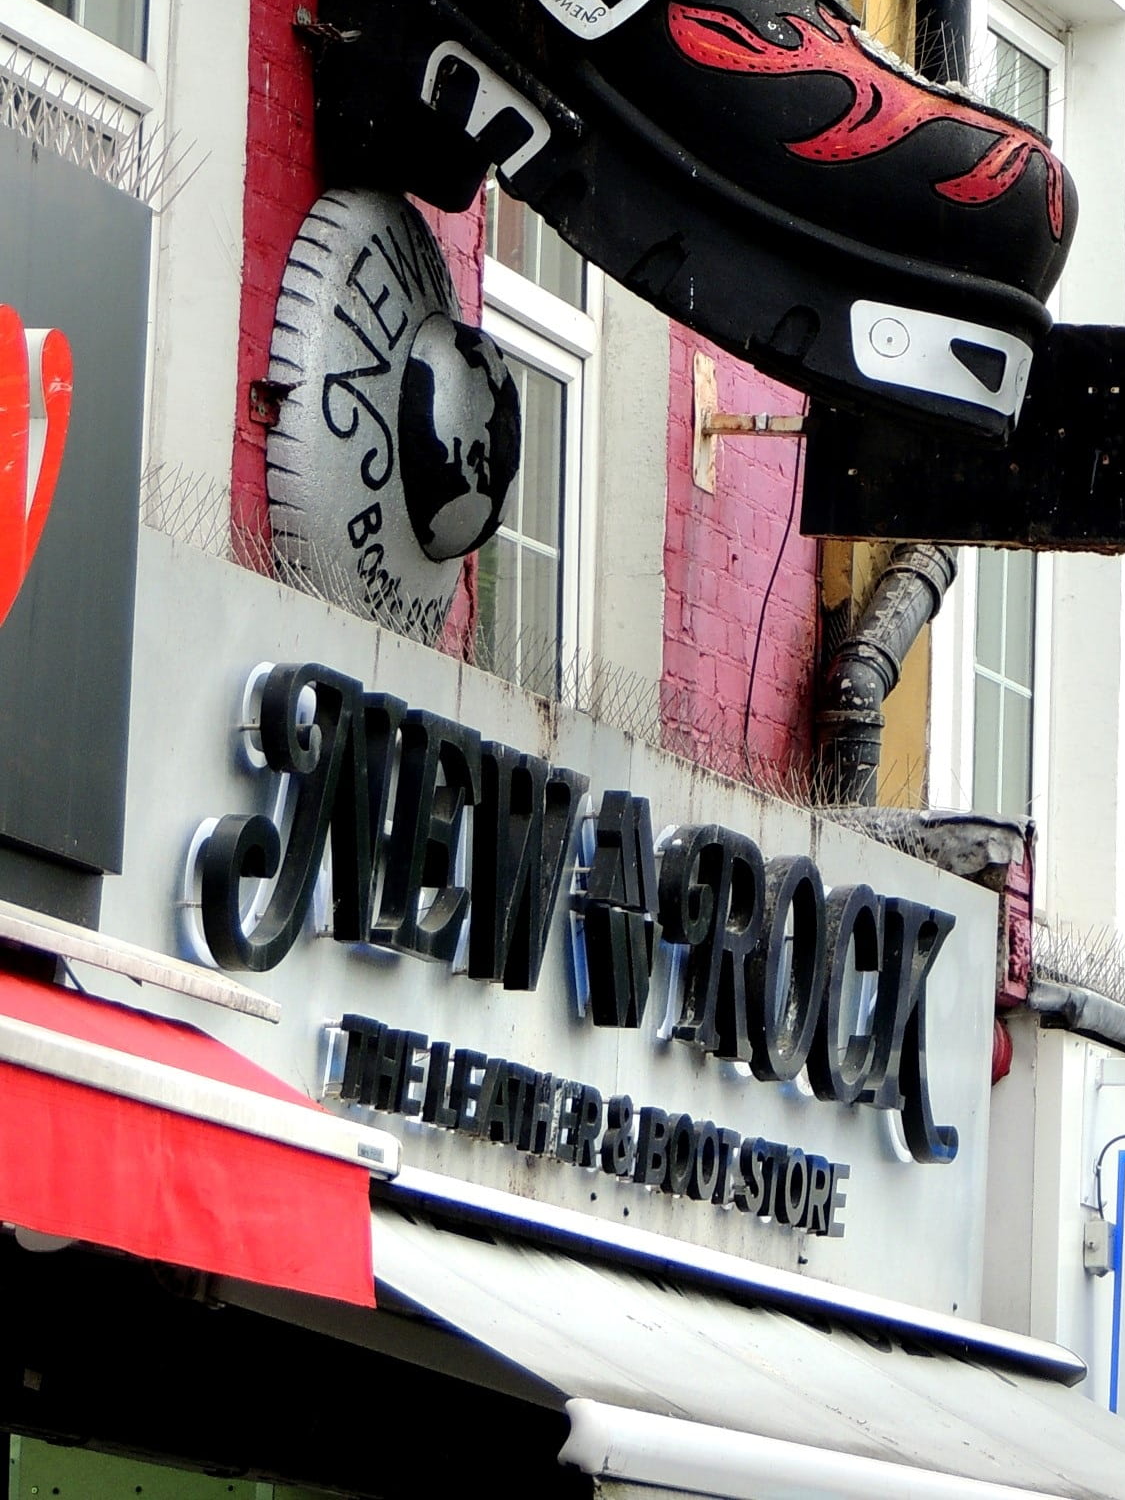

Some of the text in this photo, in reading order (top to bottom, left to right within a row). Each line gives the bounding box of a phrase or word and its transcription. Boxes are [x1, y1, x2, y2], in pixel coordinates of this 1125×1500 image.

[321, 212, 426, 491] NEW
[201, 661, 958, 1164] NEW ROCK
[342, 1013, 850, 1238] THE LEATHER & BOOT STORE
